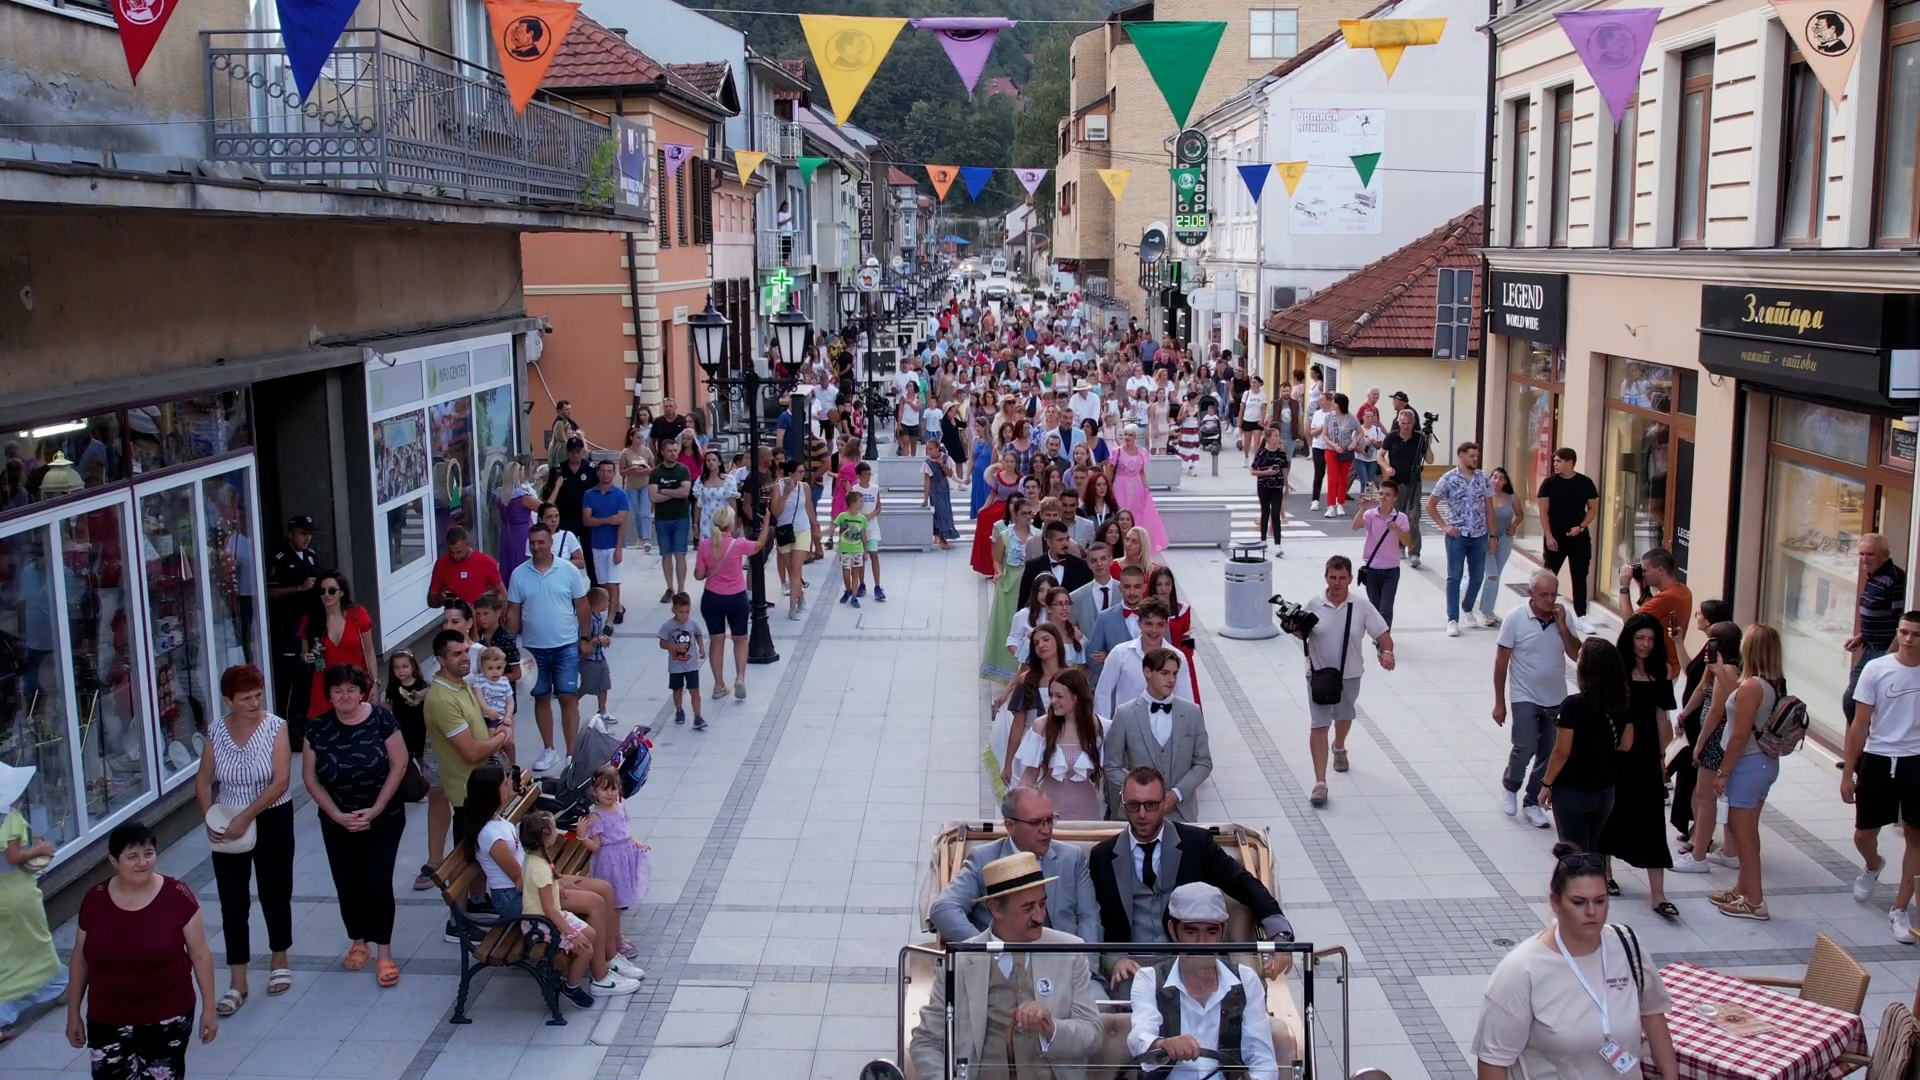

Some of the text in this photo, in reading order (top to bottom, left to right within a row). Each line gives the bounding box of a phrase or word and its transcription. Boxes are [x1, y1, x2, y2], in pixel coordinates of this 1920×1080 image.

[861, 189, 871, 234] ЗЛАТАРА
[1502, 282, 1543, 310] LEGEND
[1505, 313, 1539, 331] WORLD WIDE
[439, 363, 467, 382] INFO CENTER
[1677, 526, 1690, 540] LEGE
